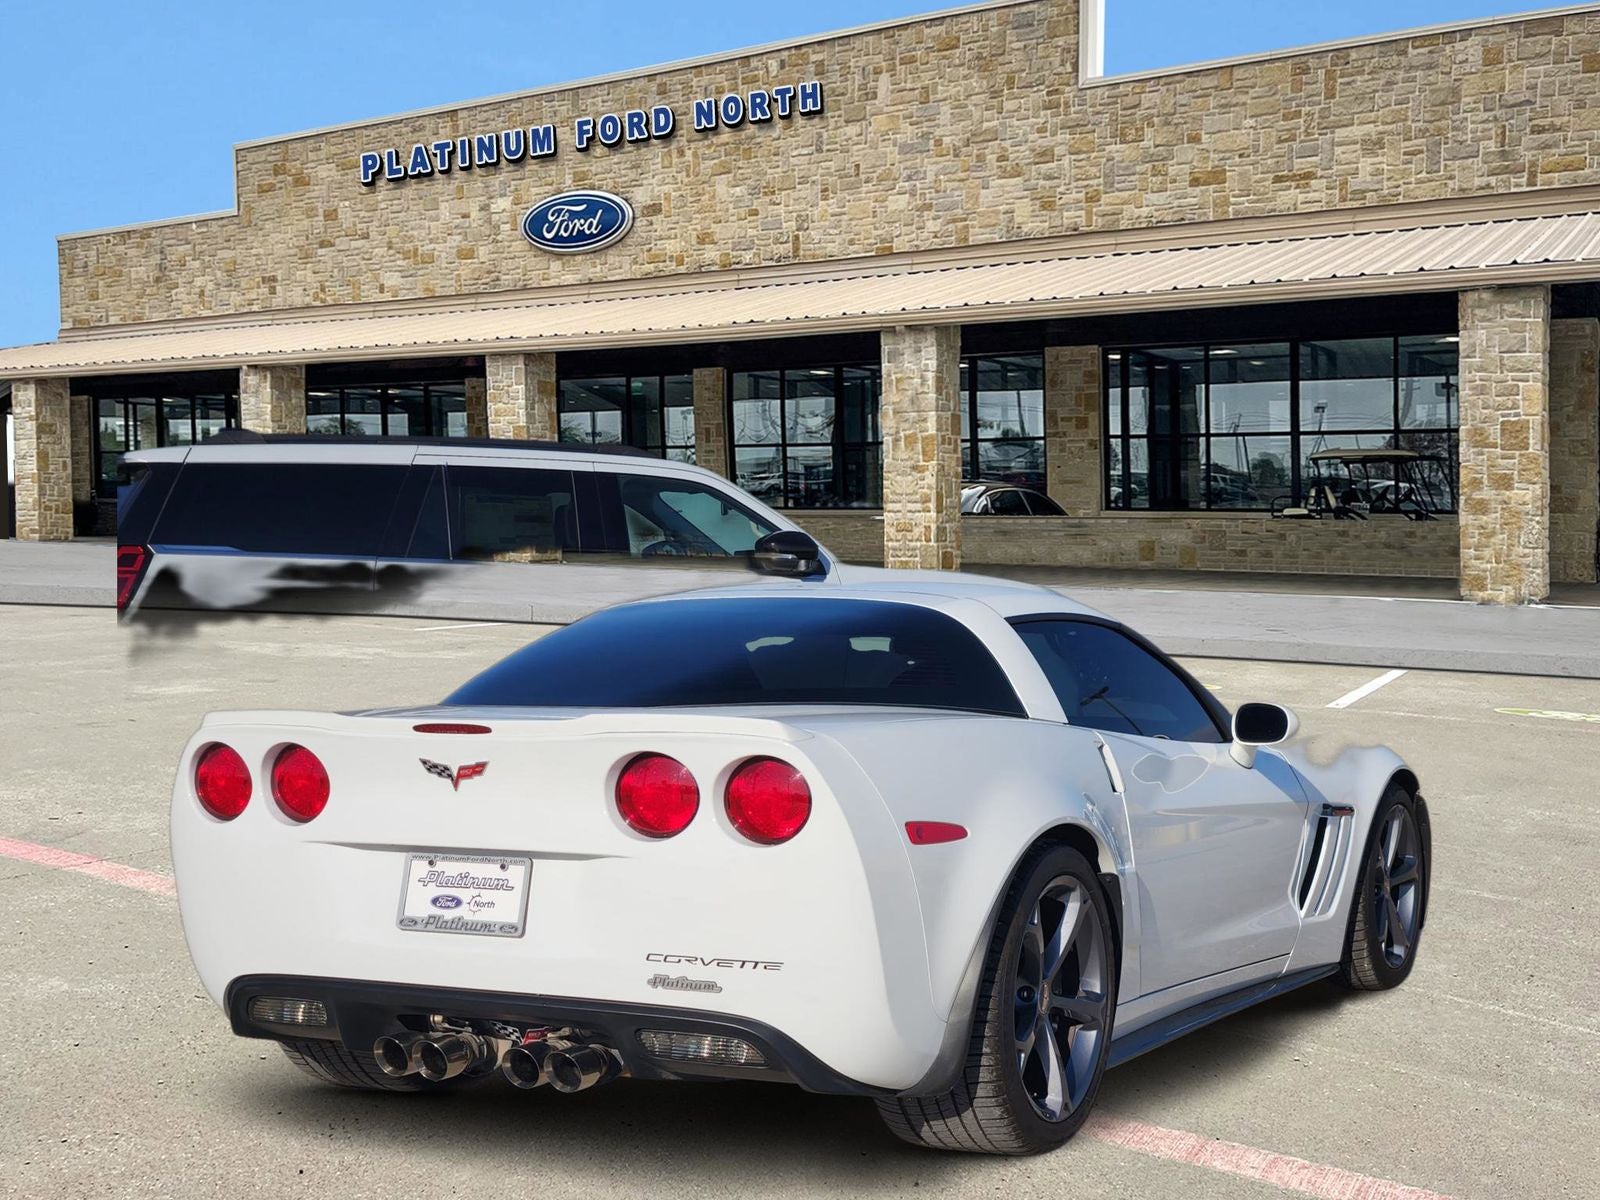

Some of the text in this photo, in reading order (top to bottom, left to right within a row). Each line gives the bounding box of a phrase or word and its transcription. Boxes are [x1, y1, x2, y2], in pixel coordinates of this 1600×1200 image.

[360, 81, 824, 186] PLATINUM FORD NORTH
[542, 203, 602, 239] Ford
[418, 870, 515, 890] Platinum
[436, 896, 495, 908] Ford North
[422, 914, 497, 933] Platinum
[646, 953, 785, 970] CORVETTE
[647, 974, 723, 993] Platinum
